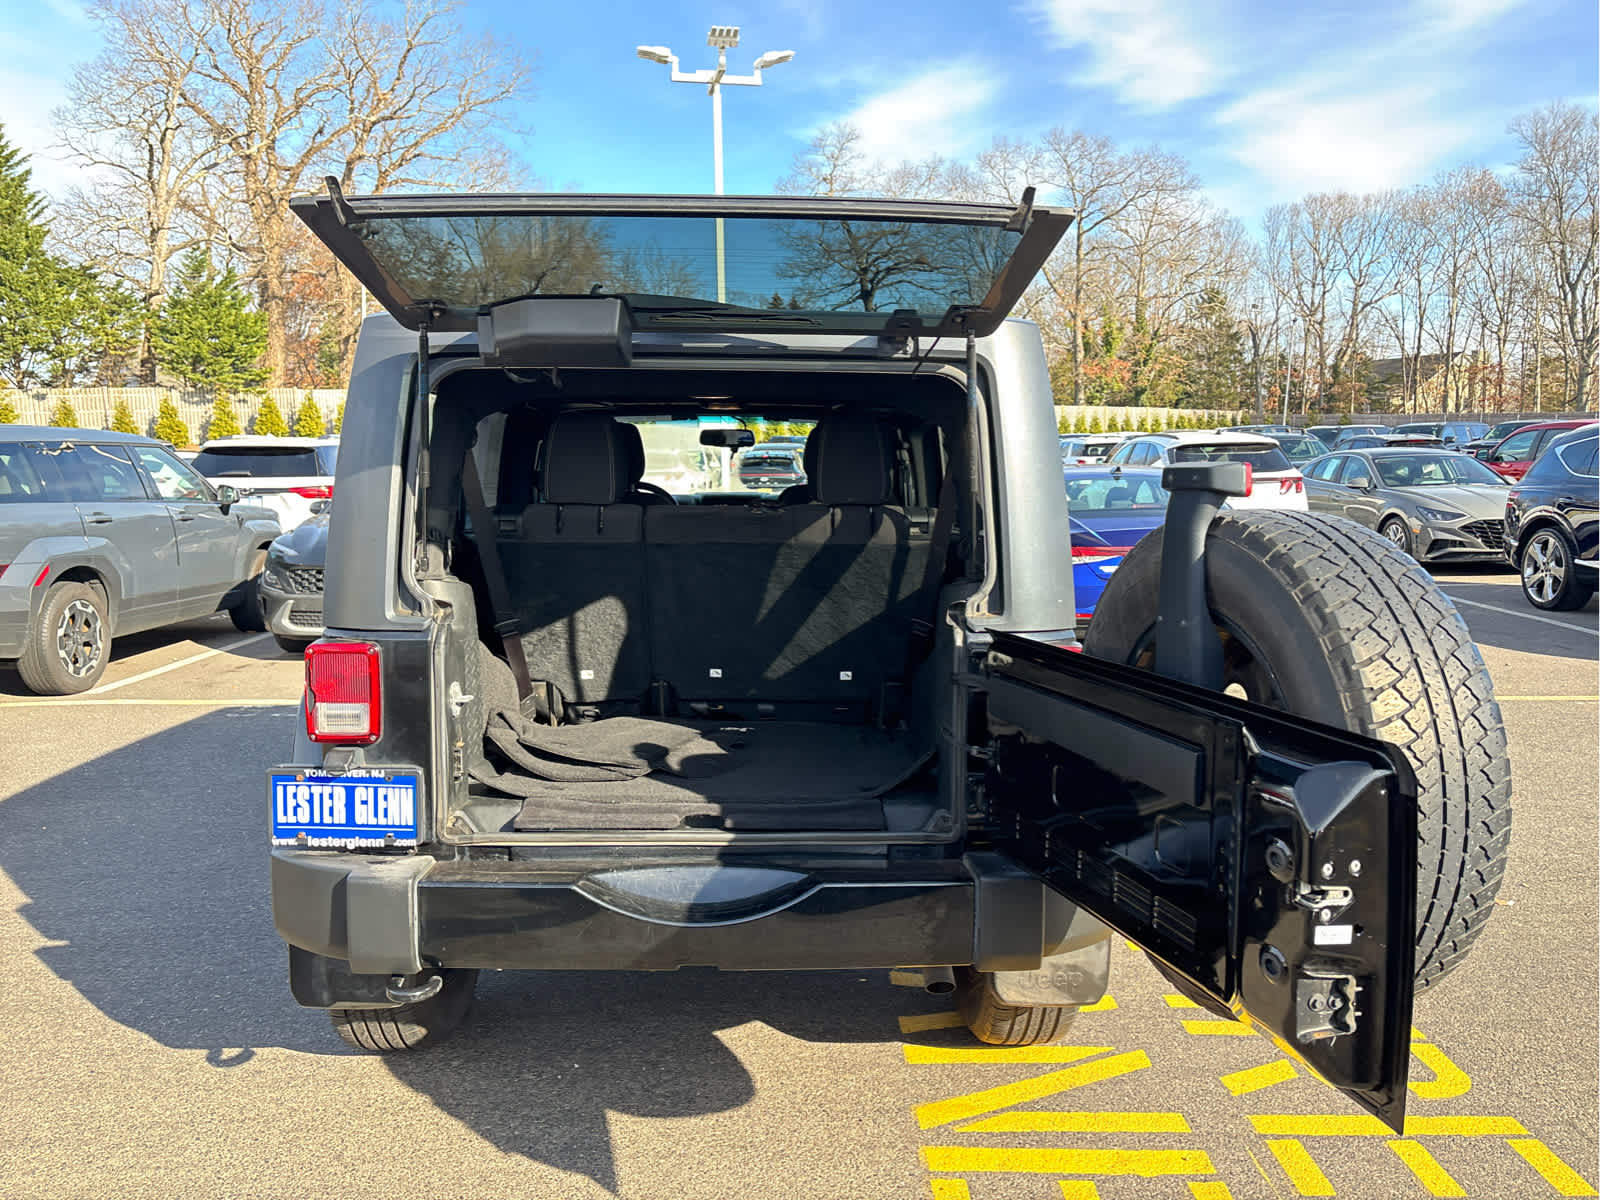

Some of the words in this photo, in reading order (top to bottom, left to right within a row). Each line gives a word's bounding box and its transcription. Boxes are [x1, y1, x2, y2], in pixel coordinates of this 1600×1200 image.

[304, 769, 334, 778] TOM
[371, 769, 385, 778] NJ
[276, 785, 347, 824] LESTER
[354, 786, 414, 826] GLENN
